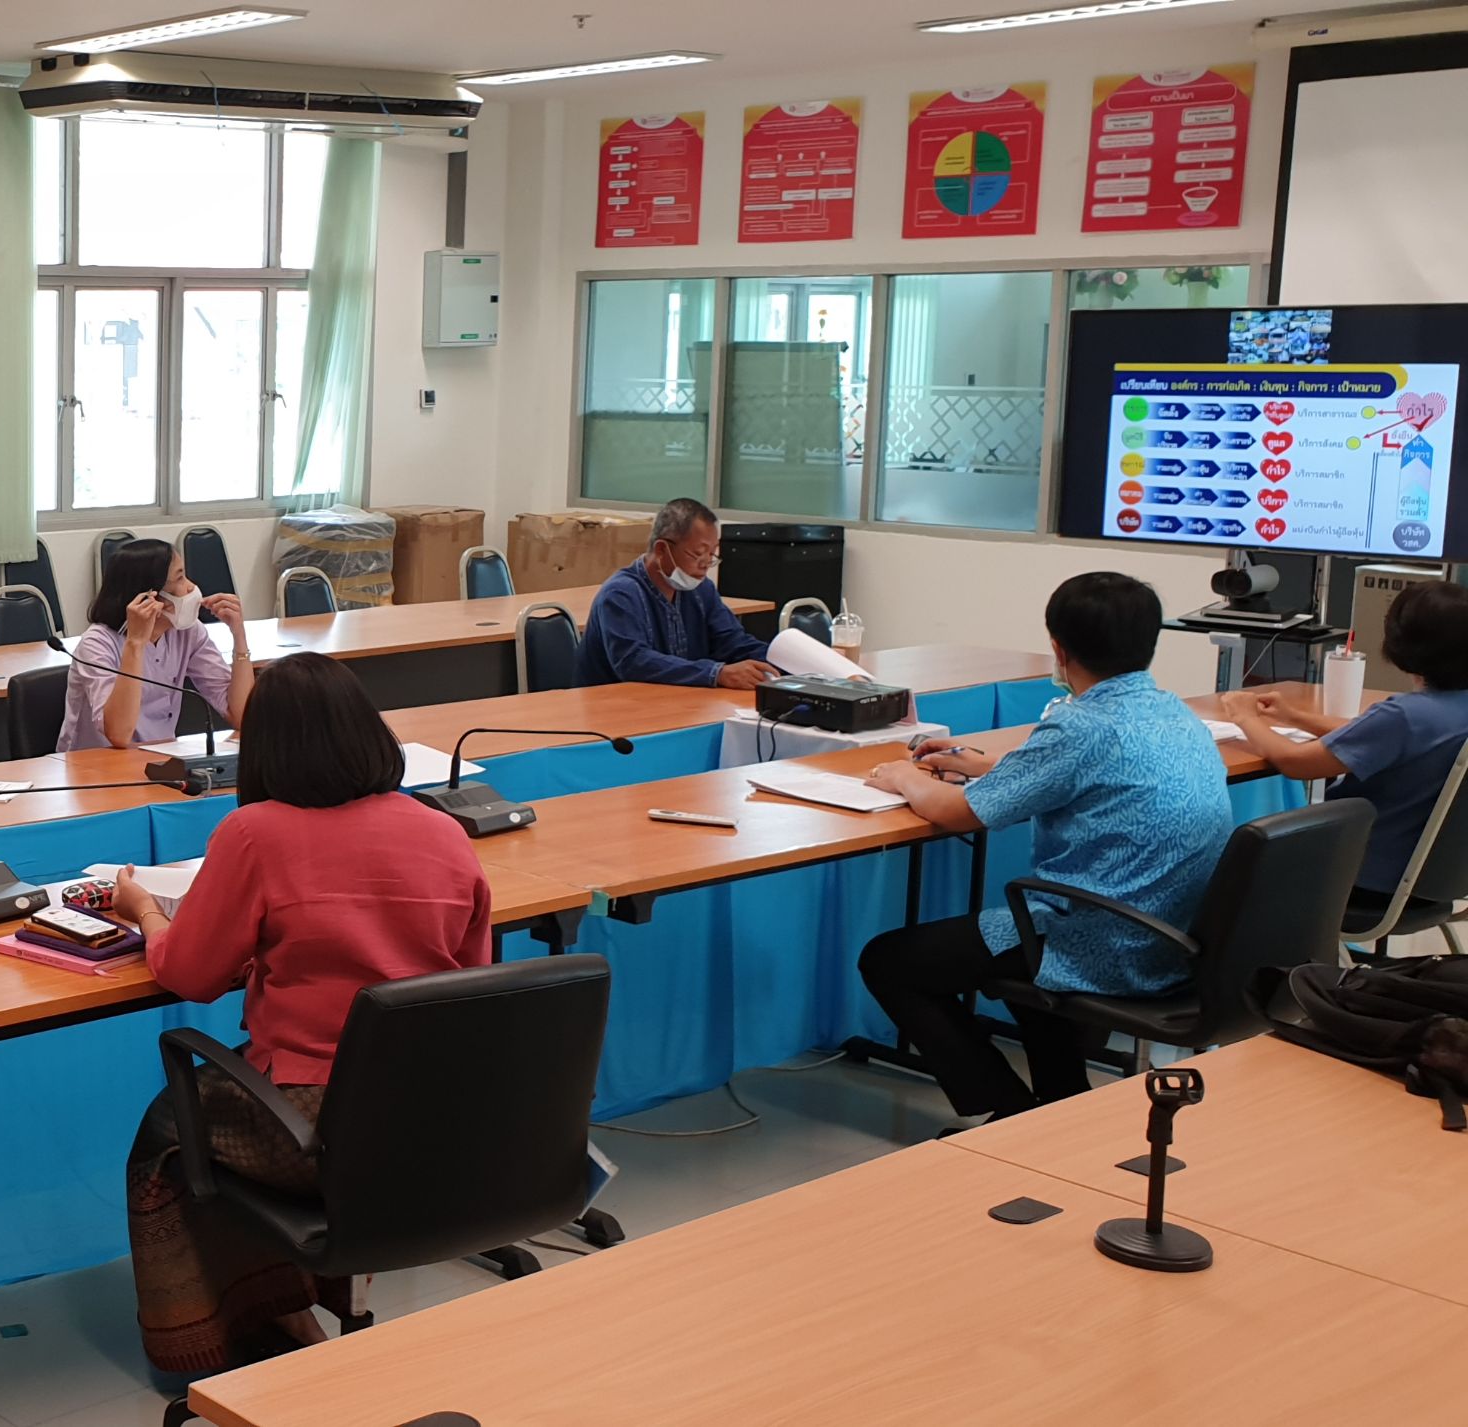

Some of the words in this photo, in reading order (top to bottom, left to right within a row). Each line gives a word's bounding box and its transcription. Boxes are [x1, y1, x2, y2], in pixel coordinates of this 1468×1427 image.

[1298, 381, 1328, 392] กิจการ
[1338, 382, 1381, 393] เป้าหมาย
[1406, 405, 1434, 417] กำไร
